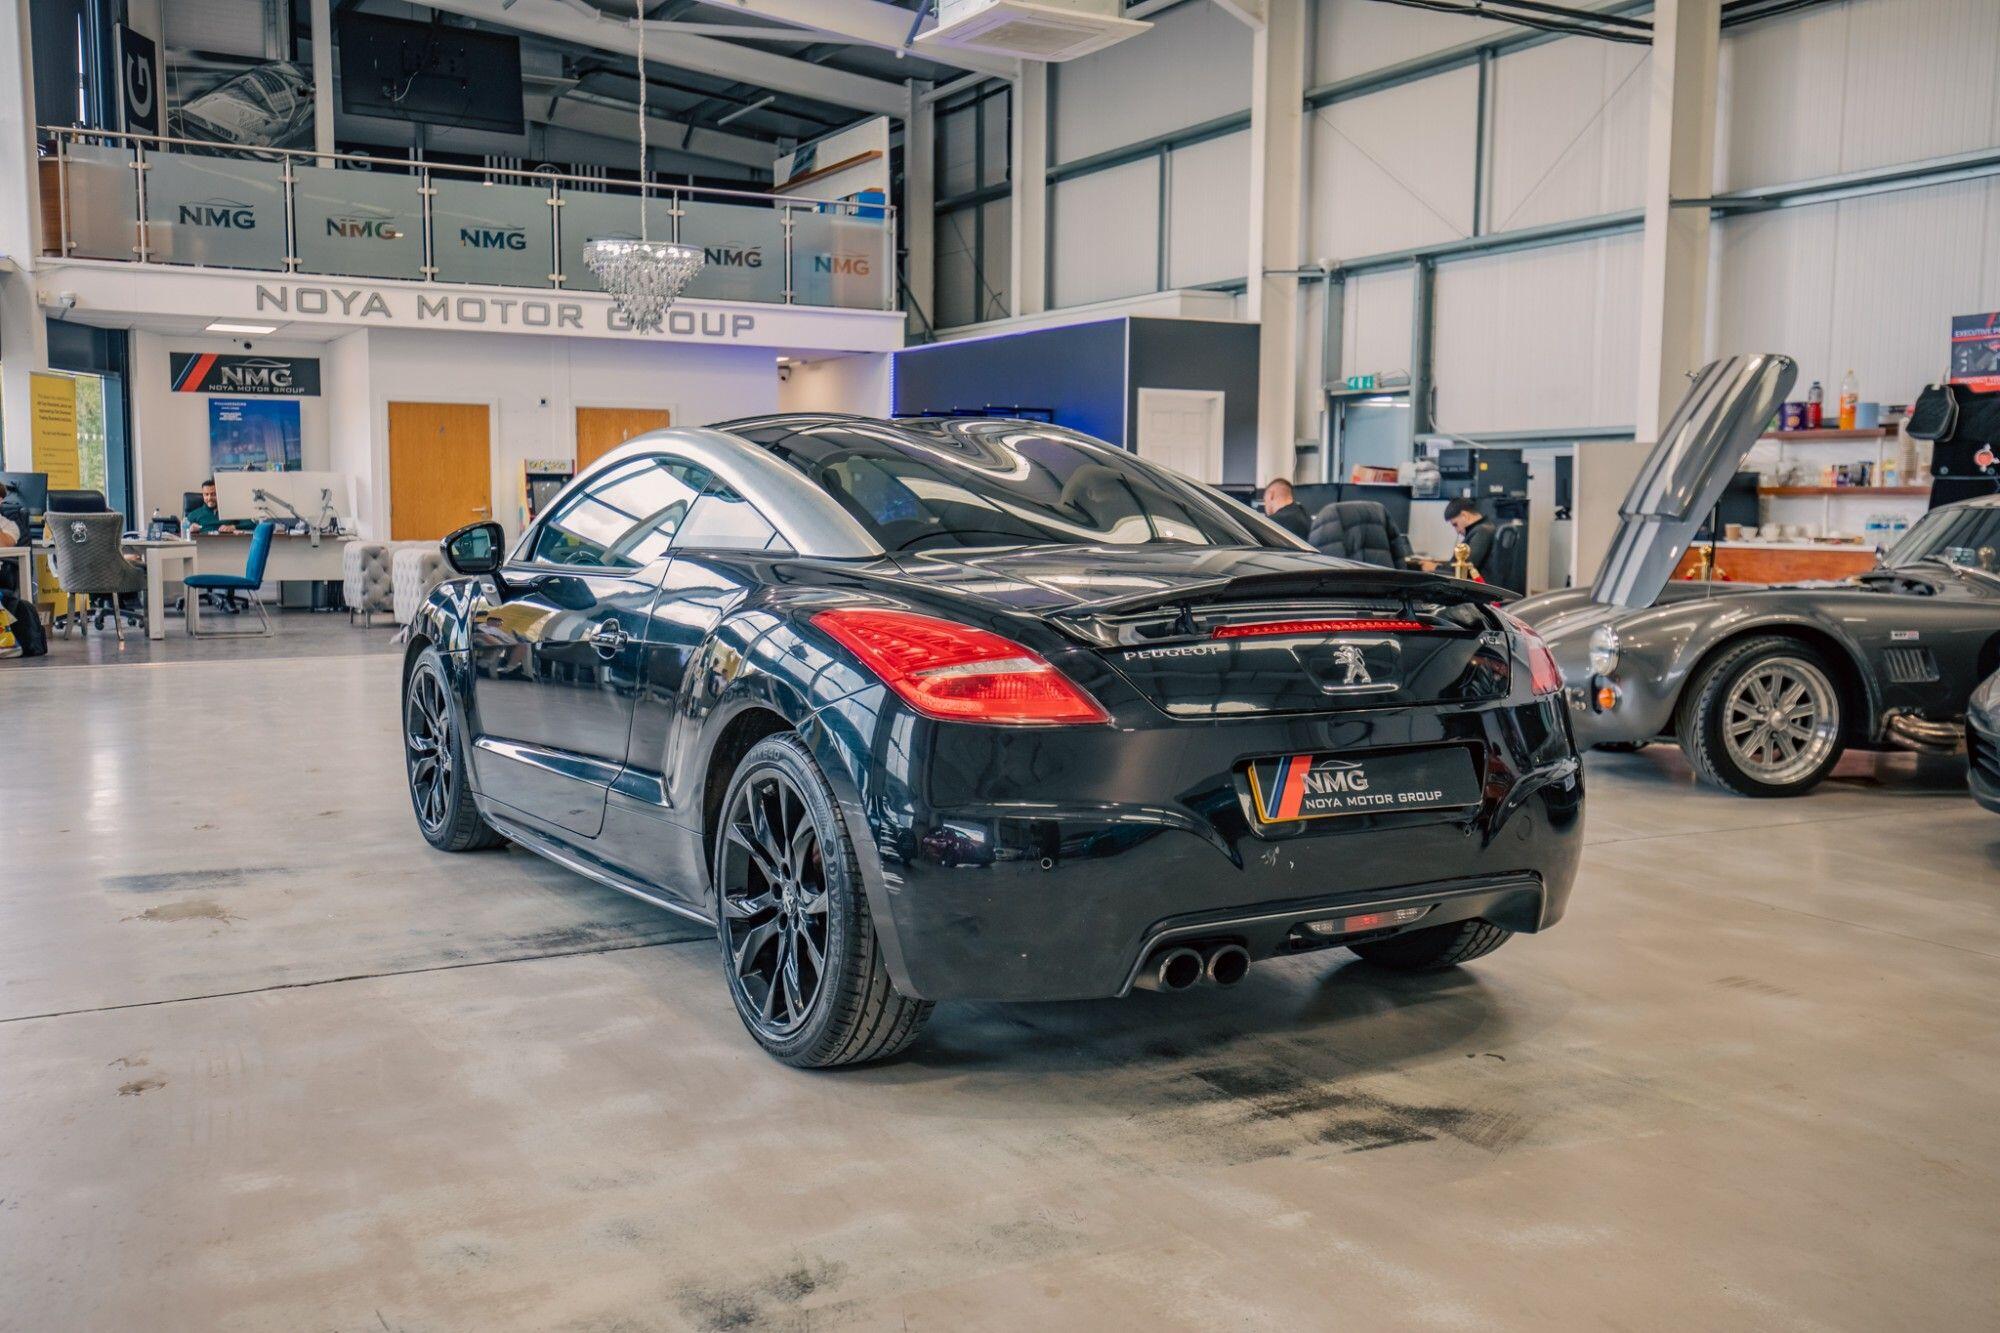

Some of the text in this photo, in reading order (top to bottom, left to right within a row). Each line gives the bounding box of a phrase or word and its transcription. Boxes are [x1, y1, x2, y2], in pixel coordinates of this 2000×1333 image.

[179, 205, 256, 230] NMG
[326, 217, 396, 240] NMG
[460, 228, 527, 250] NMG
[704, 247, 762, 268] NMG
[815, 256, 870, 276] NMG
[256, 284, 392, 319] NOYA
[417, 294, 583, 329] MOTOR
[220, 366, 293, 388] NMG
[237, 385, 270, 393] MOTOR
[273, 386, 305, 394] GROUP
[1123, 646, 1218, 661] PEUGEOT
[1300, 769, 1370, 795] NMG
[1305, 790, 1443, 810] NOYA MOTOR GROUP
